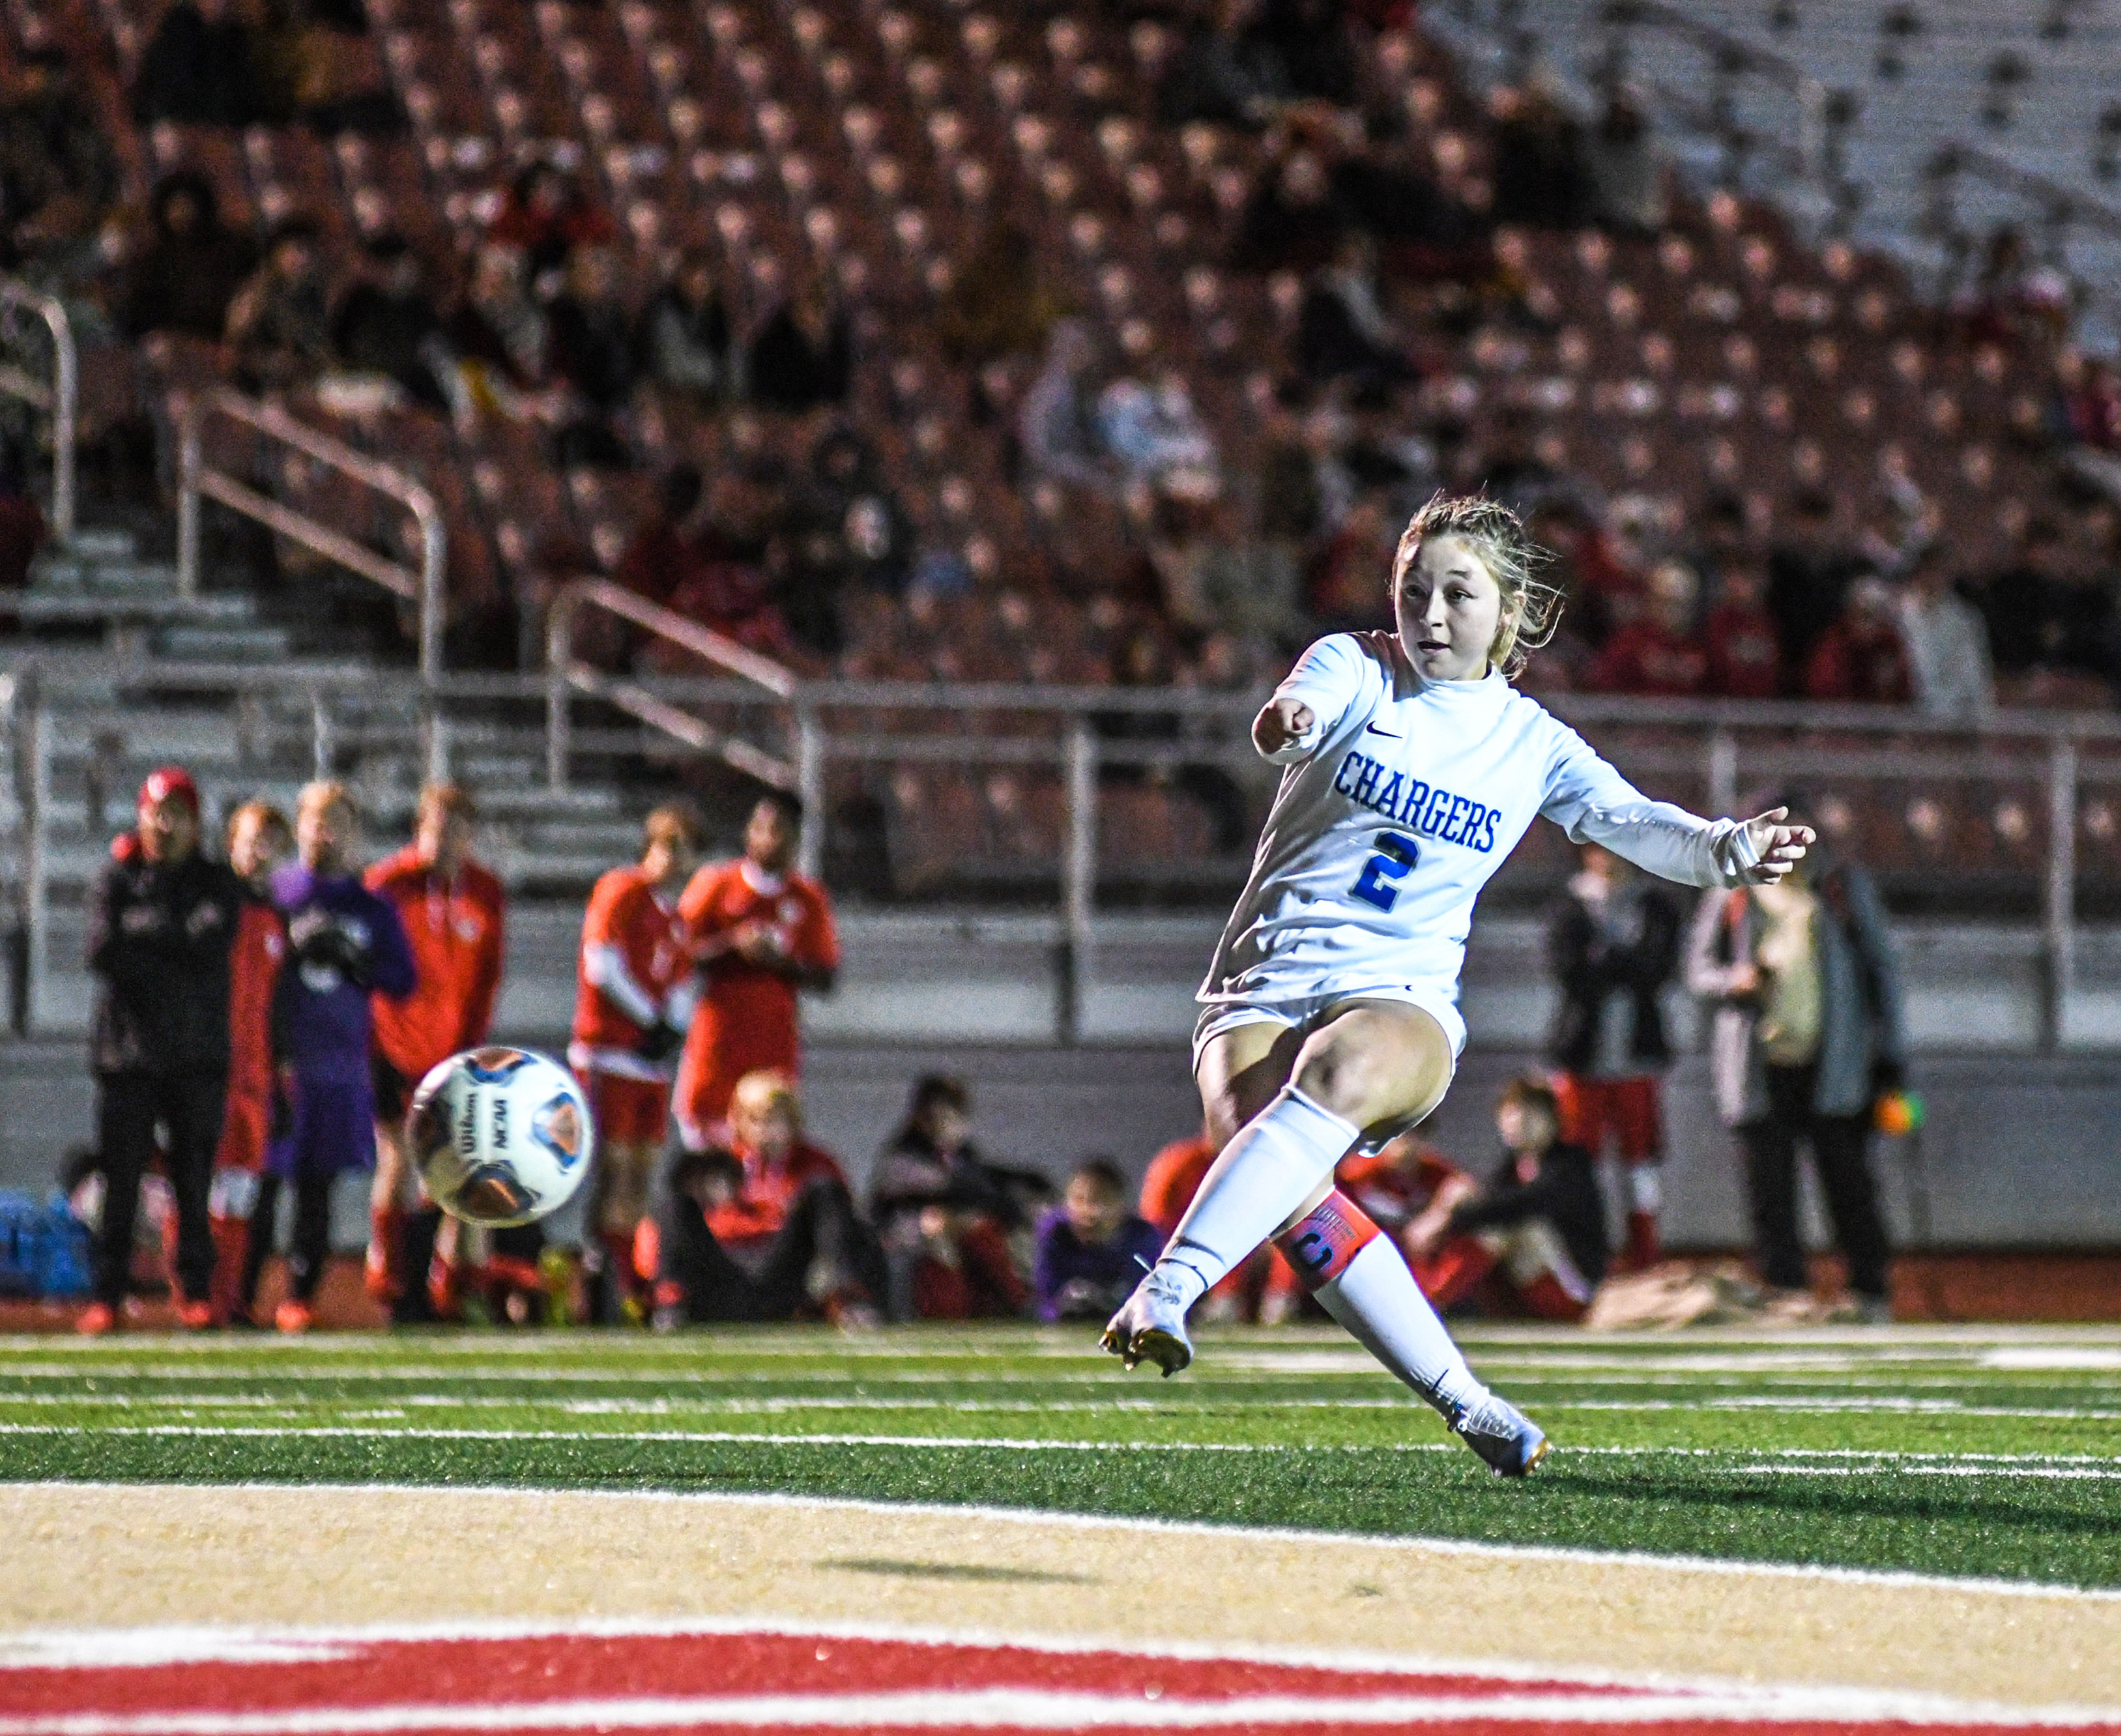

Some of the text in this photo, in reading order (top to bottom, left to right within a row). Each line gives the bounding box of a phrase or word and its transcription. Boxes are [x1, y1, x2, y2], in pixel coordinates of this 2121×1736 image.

[1335, 751, 1502, 852] CHARGERS
[1349, 831, 1422, 913] 2
[493, 1099, 508, 1149] NCAA
